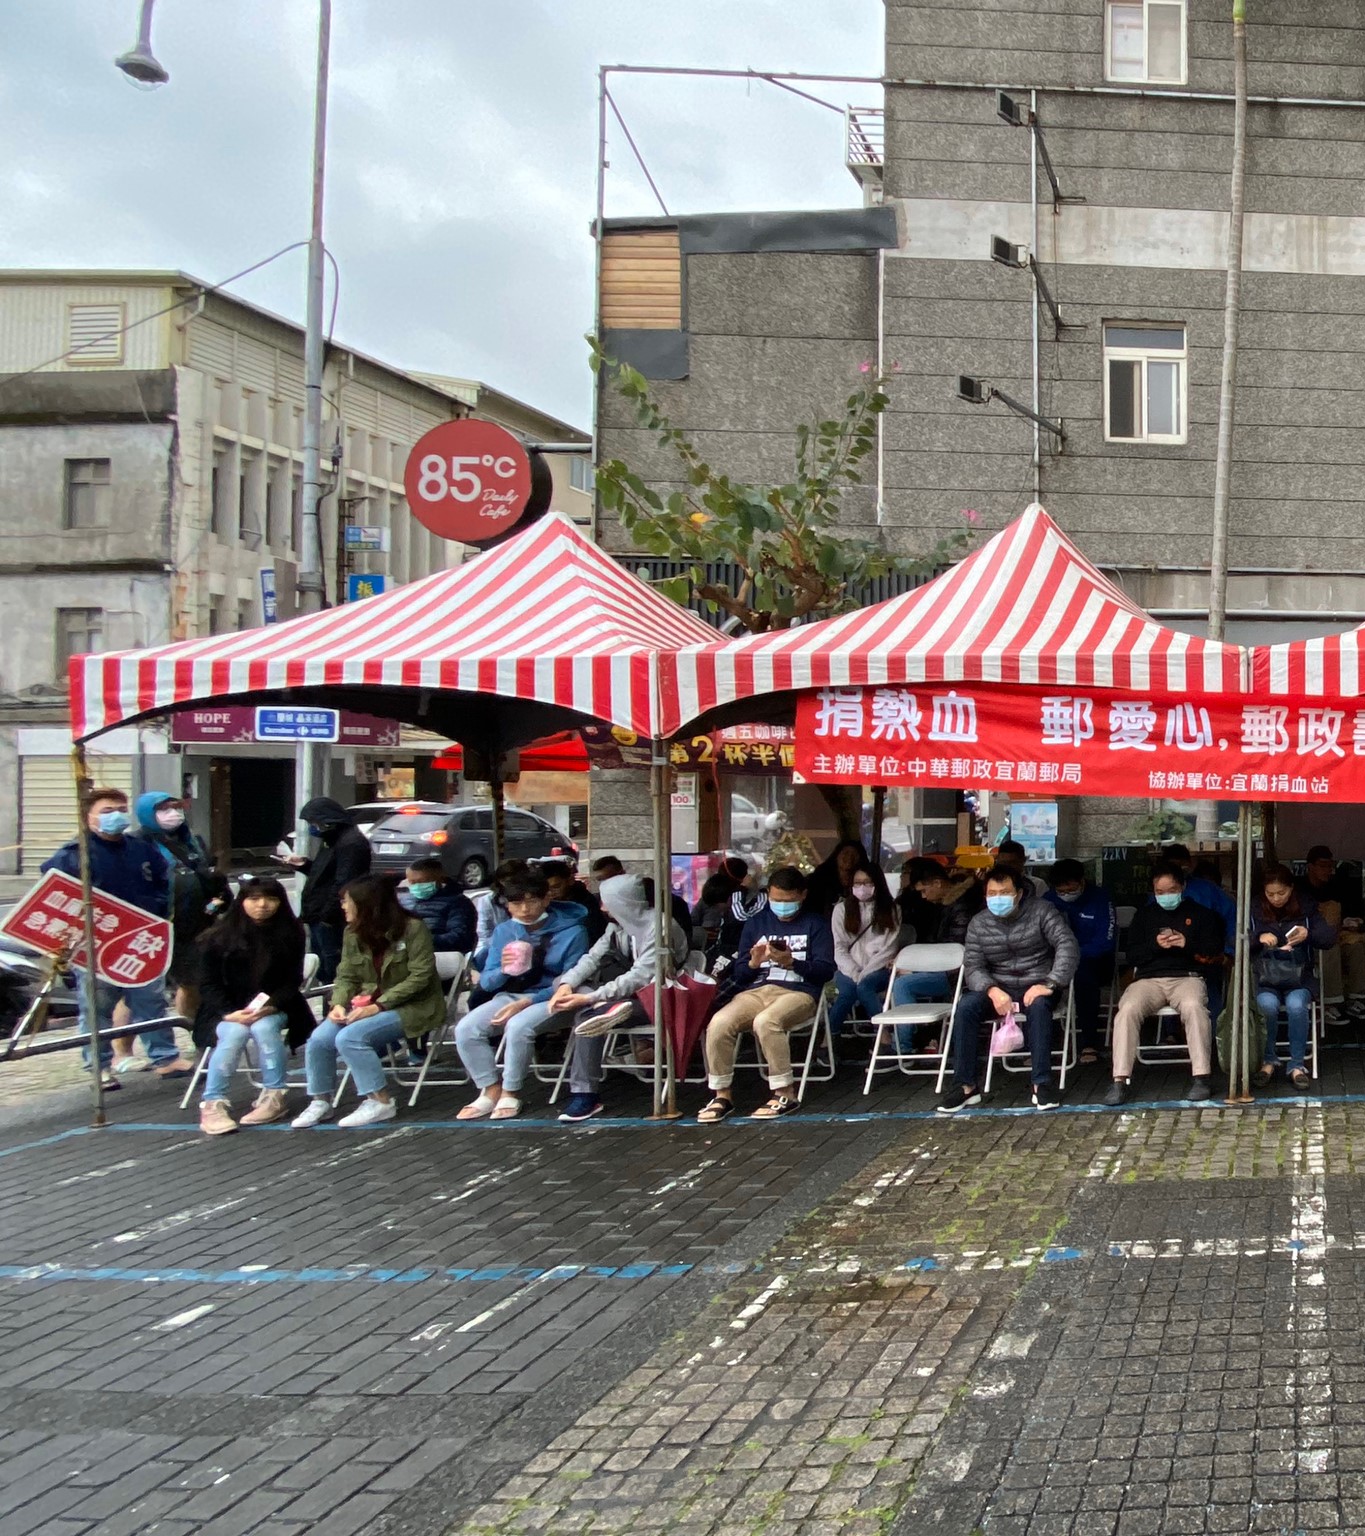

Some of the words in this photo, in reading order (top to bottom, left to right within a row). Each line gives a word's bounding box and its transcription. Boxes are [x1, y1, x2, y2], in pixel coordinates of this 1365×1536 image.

[482, 488, 519, 504] Daily
[193, 712, 232, 725] HOPE
[814, 686, 979, 743] 捐熱血
[1103, 847, 1128, 861] 22KV
